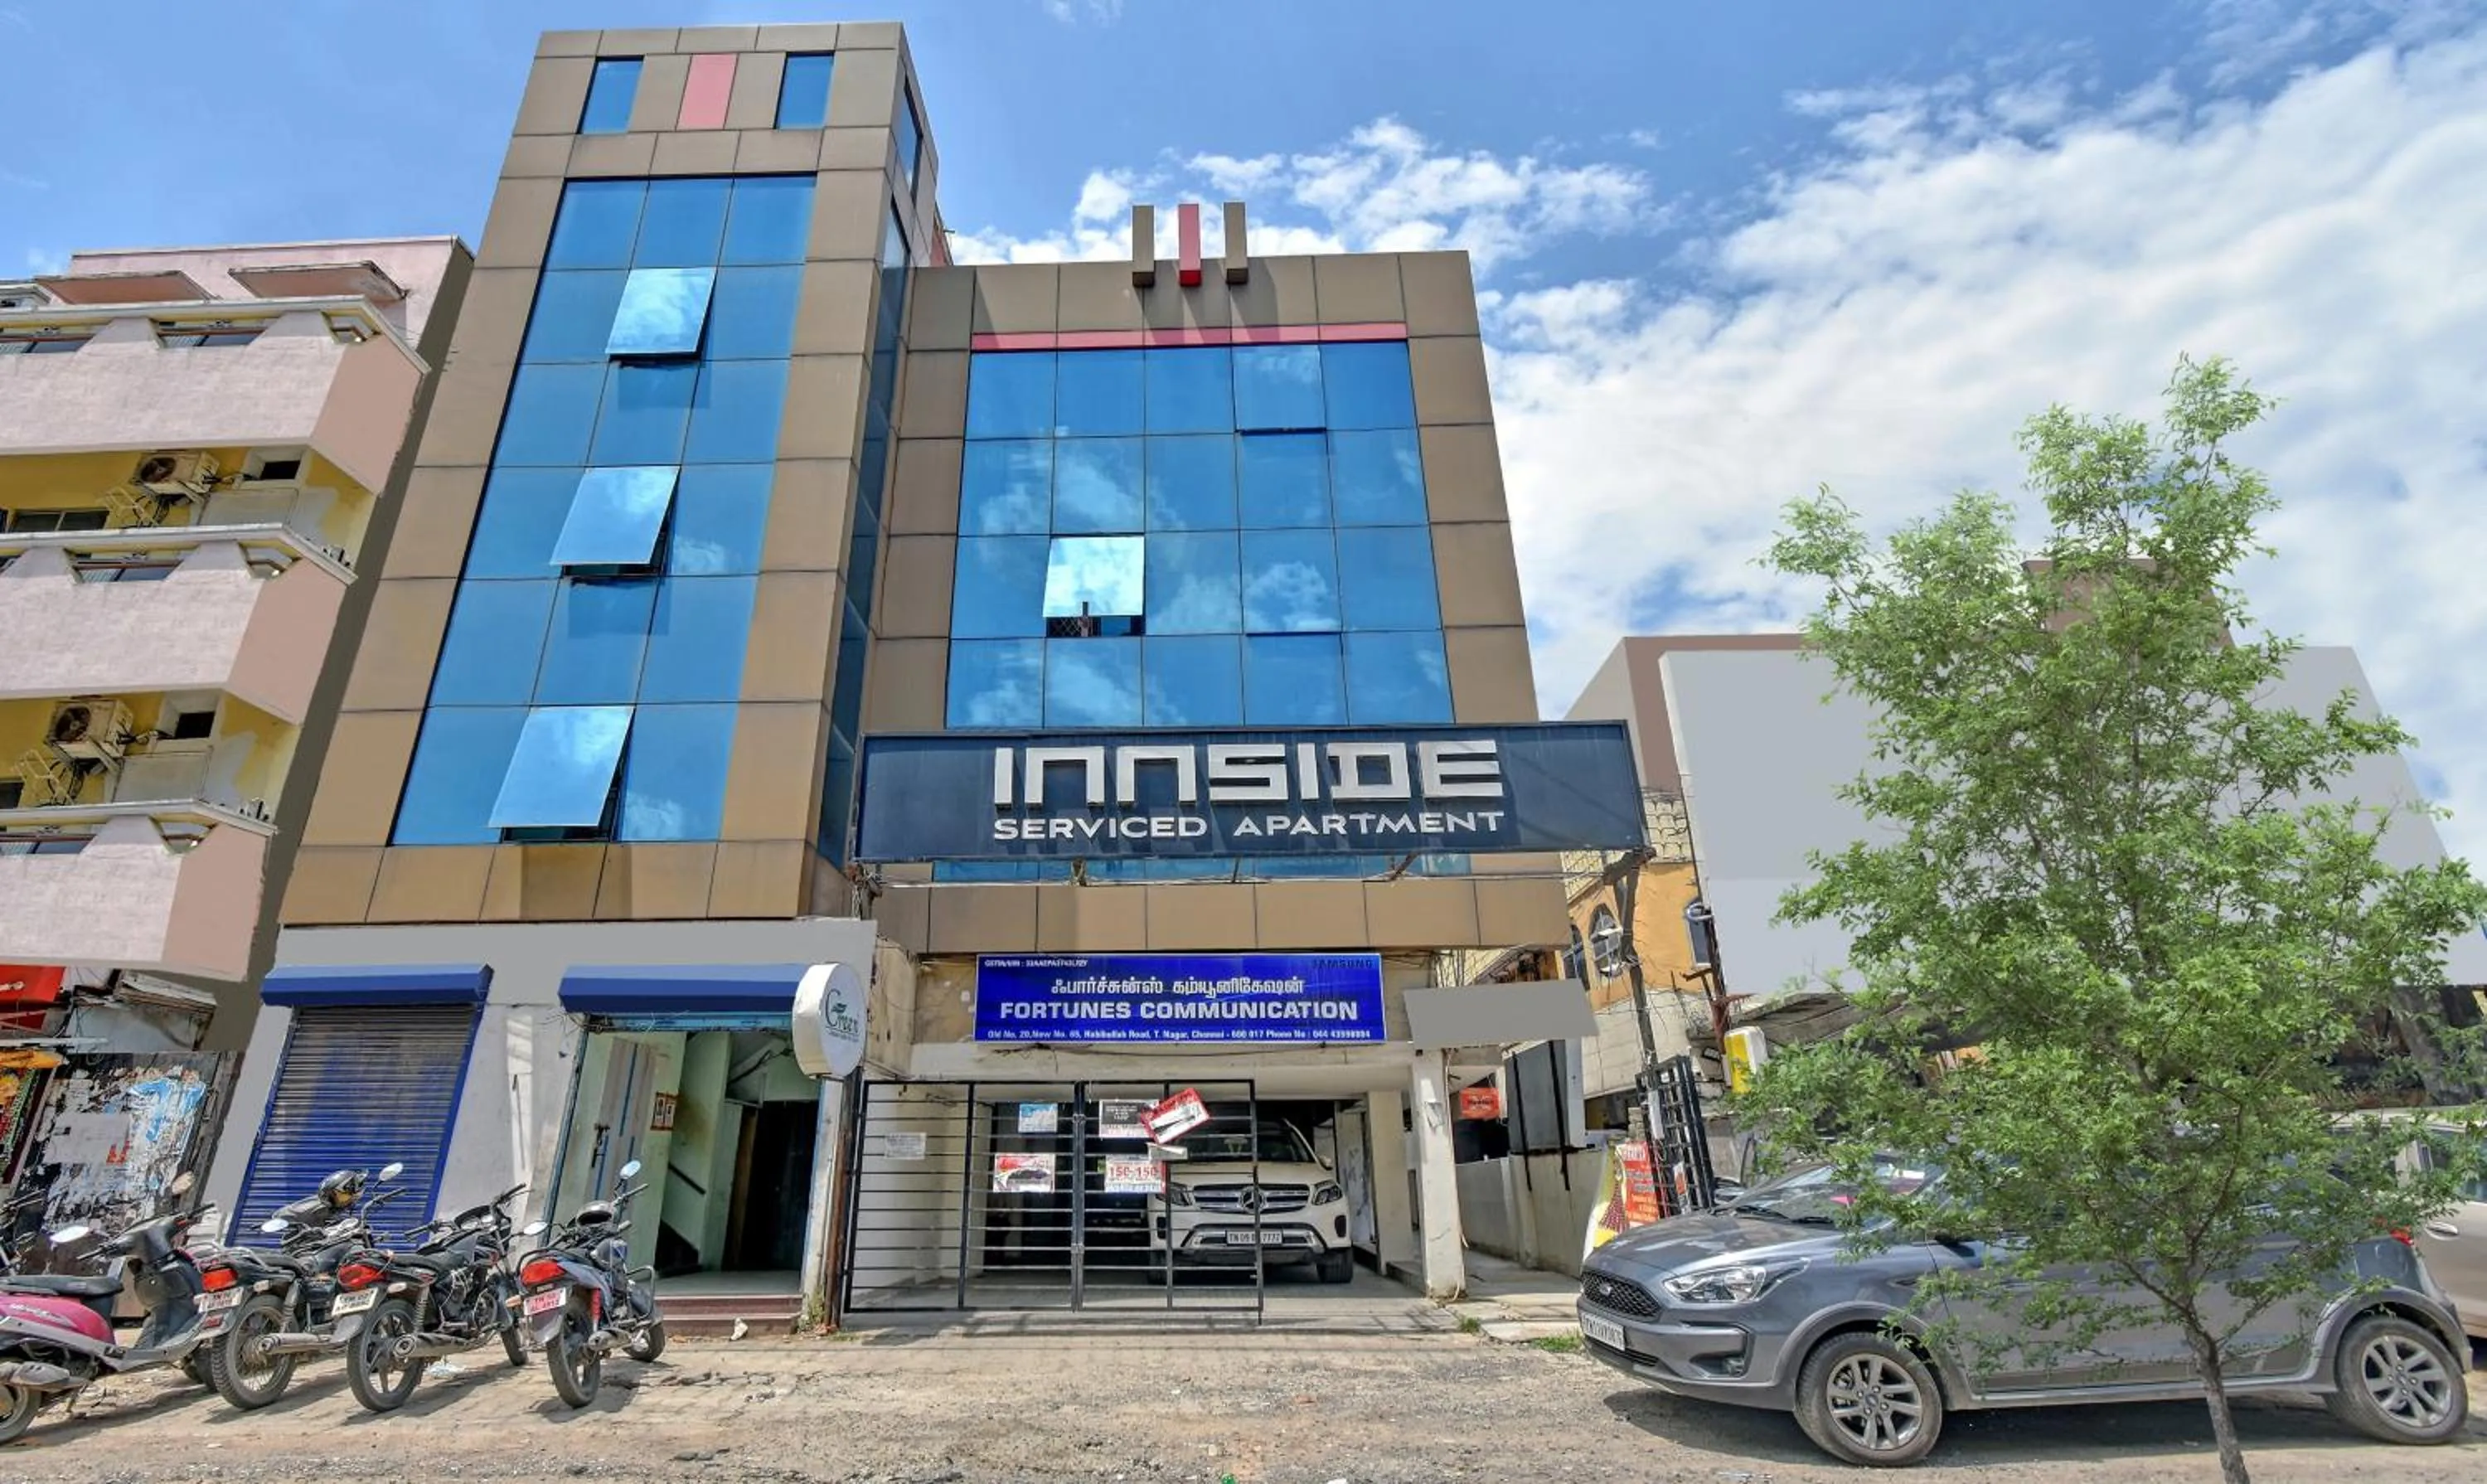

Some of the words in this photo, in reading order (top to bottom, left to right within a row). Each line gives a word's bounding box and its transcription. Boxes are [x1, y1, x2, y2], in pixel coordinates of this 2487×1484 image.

[995, 740, 1504, 806] INNSIDE
[994, 817, 1208, 840] SERVICED
[1233, 811, 1505, 837] APARTMENT
[1313, 959, 1374, 968] SAMSUNG
[1000, 1001, 1132, 1020] FORTUNES
[1140, 1001, 1359, 1020] COMMUNICATION
